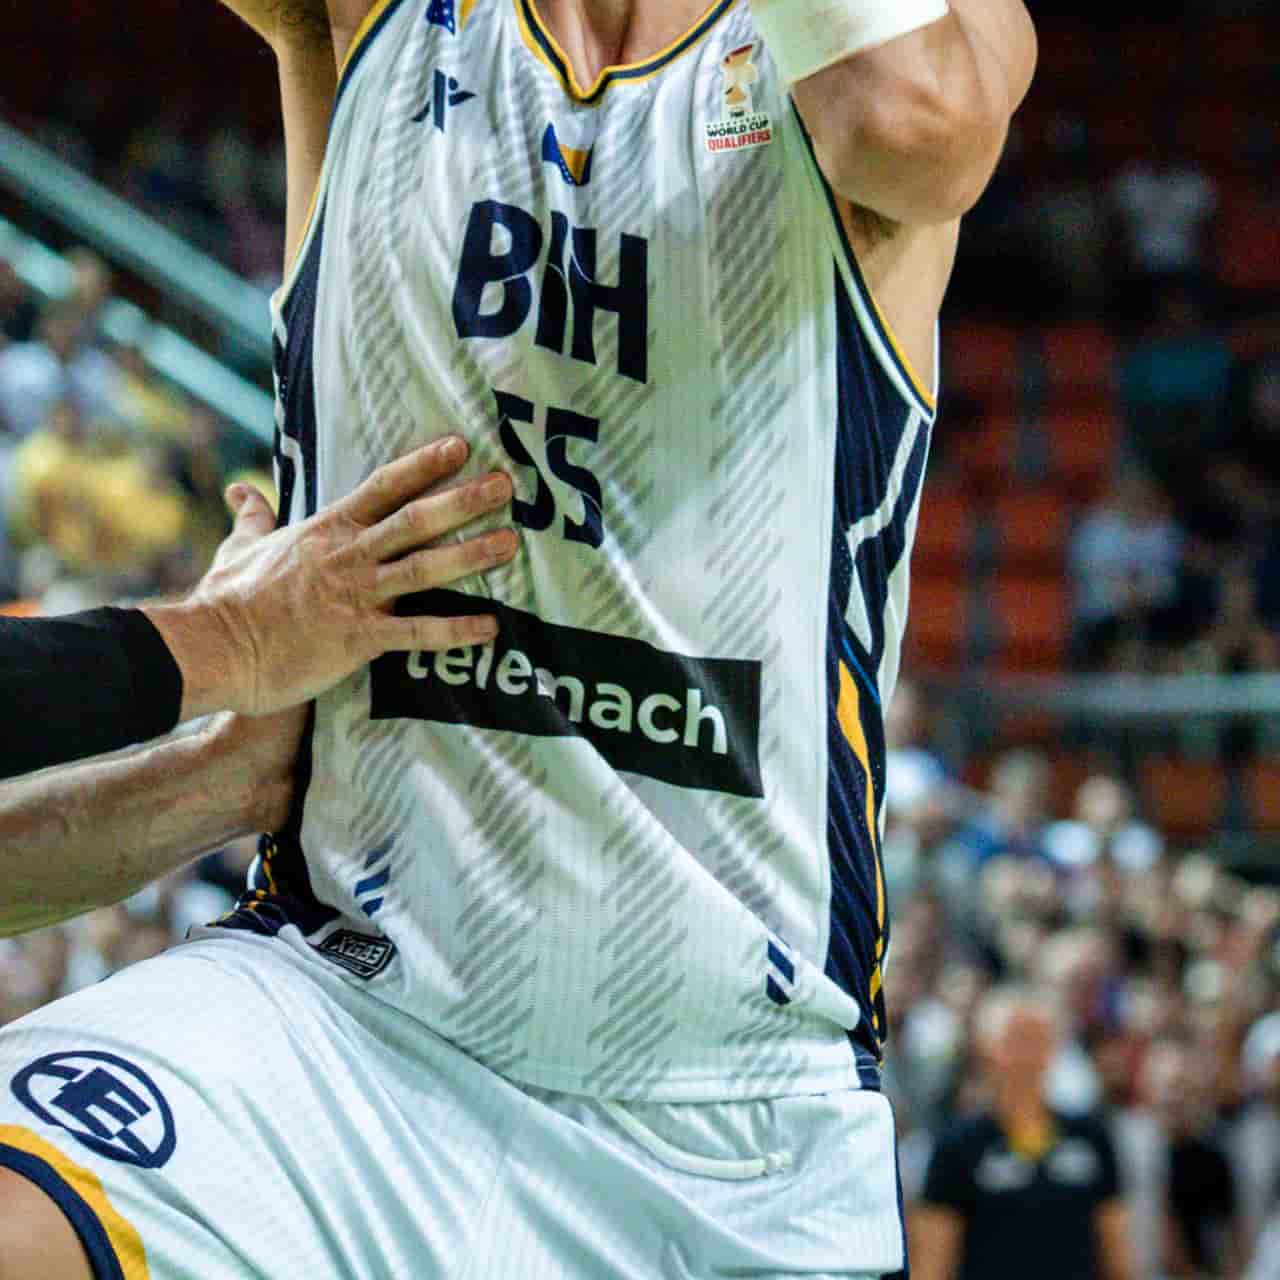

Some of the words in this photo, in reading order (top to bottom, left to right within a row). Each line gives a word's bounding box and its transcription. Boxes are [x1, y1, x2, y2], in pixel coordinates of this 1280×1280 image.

[706, 124, 747, 137] WORLD
[749, 119, 769, 131] CUP
[708, 128, 771, 151] QUALIFIERS
[491, 387, 605, 549] 55
